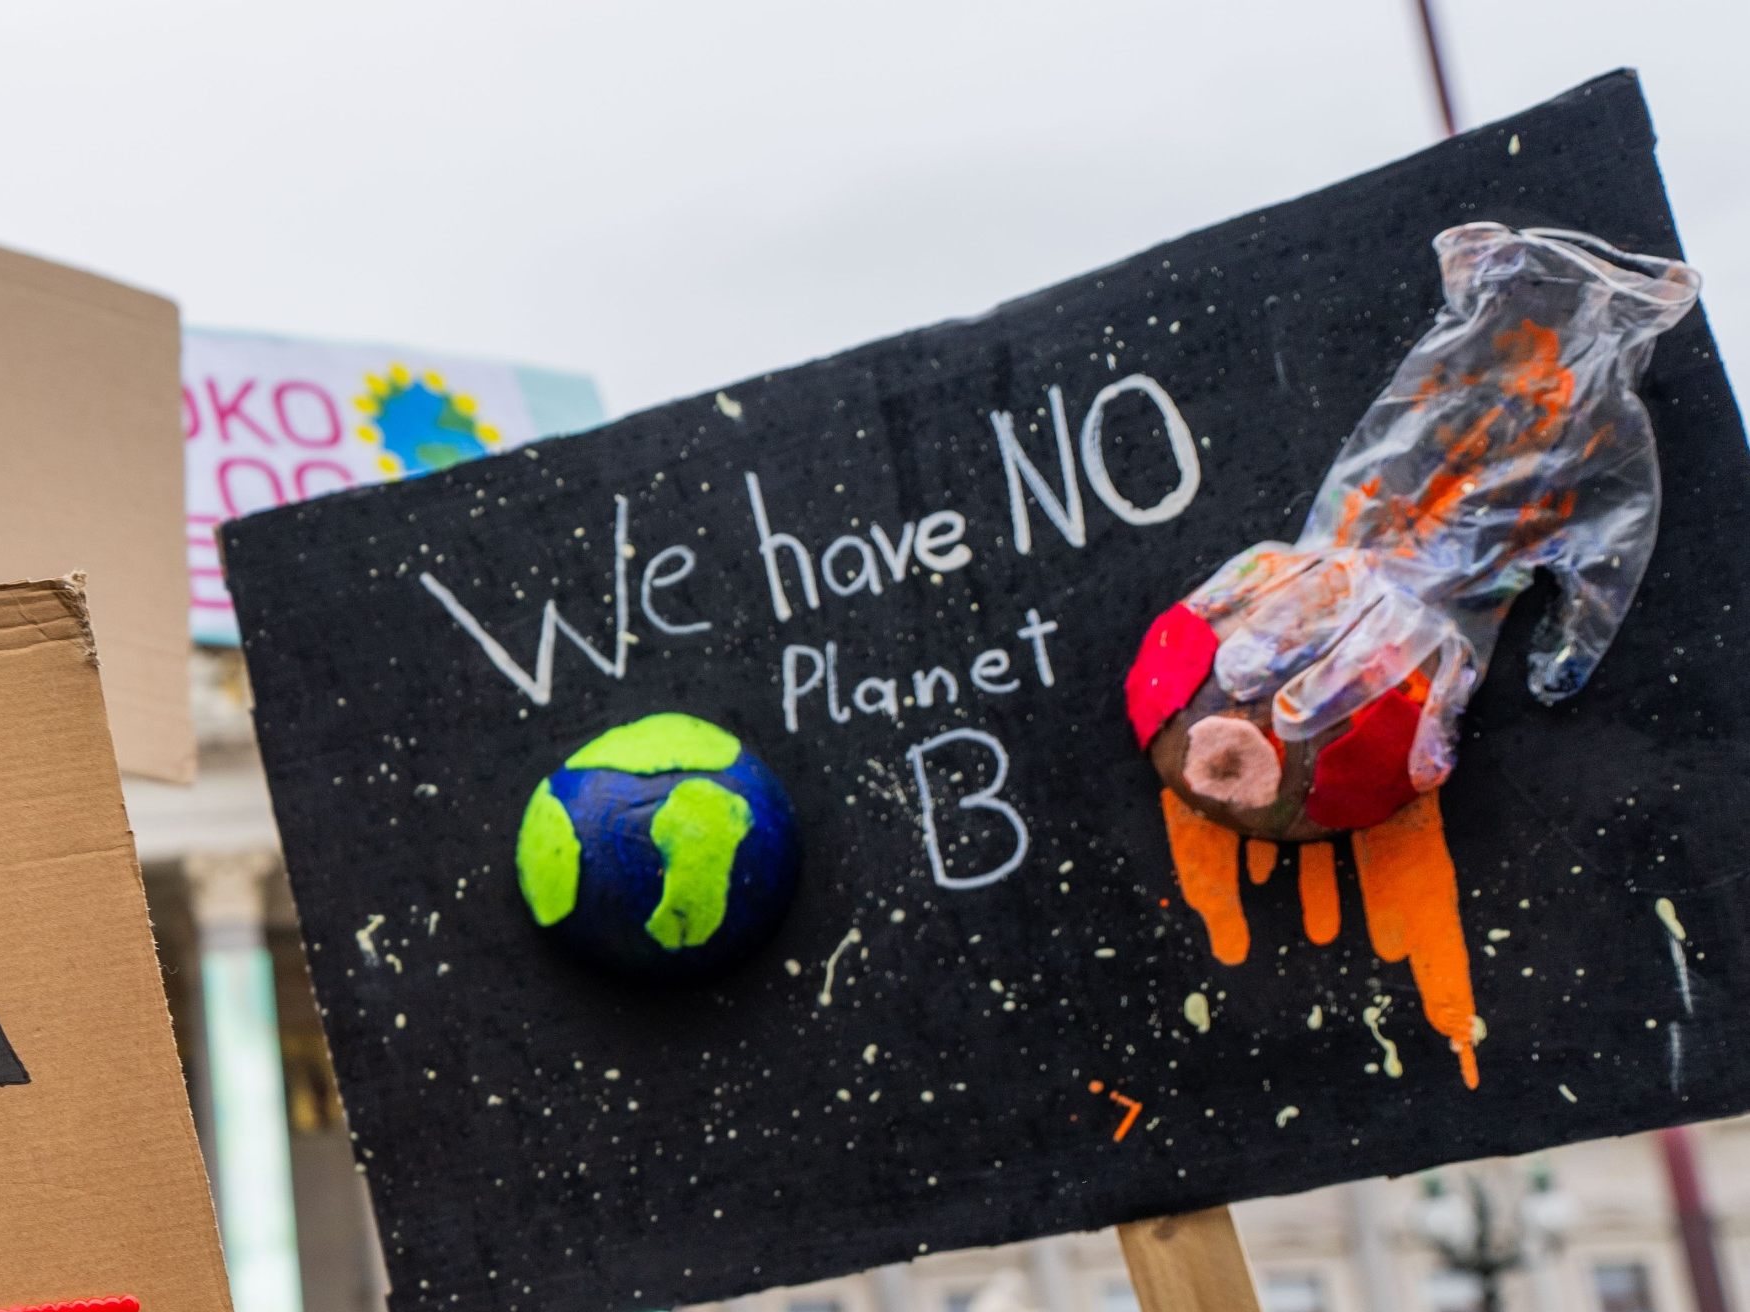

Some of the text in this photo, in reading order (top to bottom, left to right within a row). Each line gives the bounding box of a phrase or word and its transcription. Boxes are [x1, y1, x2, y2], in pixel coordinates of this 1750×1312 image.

[420, 494, 712, 706] We
[744, 471, 973, 622] have
[990, 373, 1201, 554] NO
[782, 609, 1058, 732] Planet
[906, 727, 1030, 890] B
